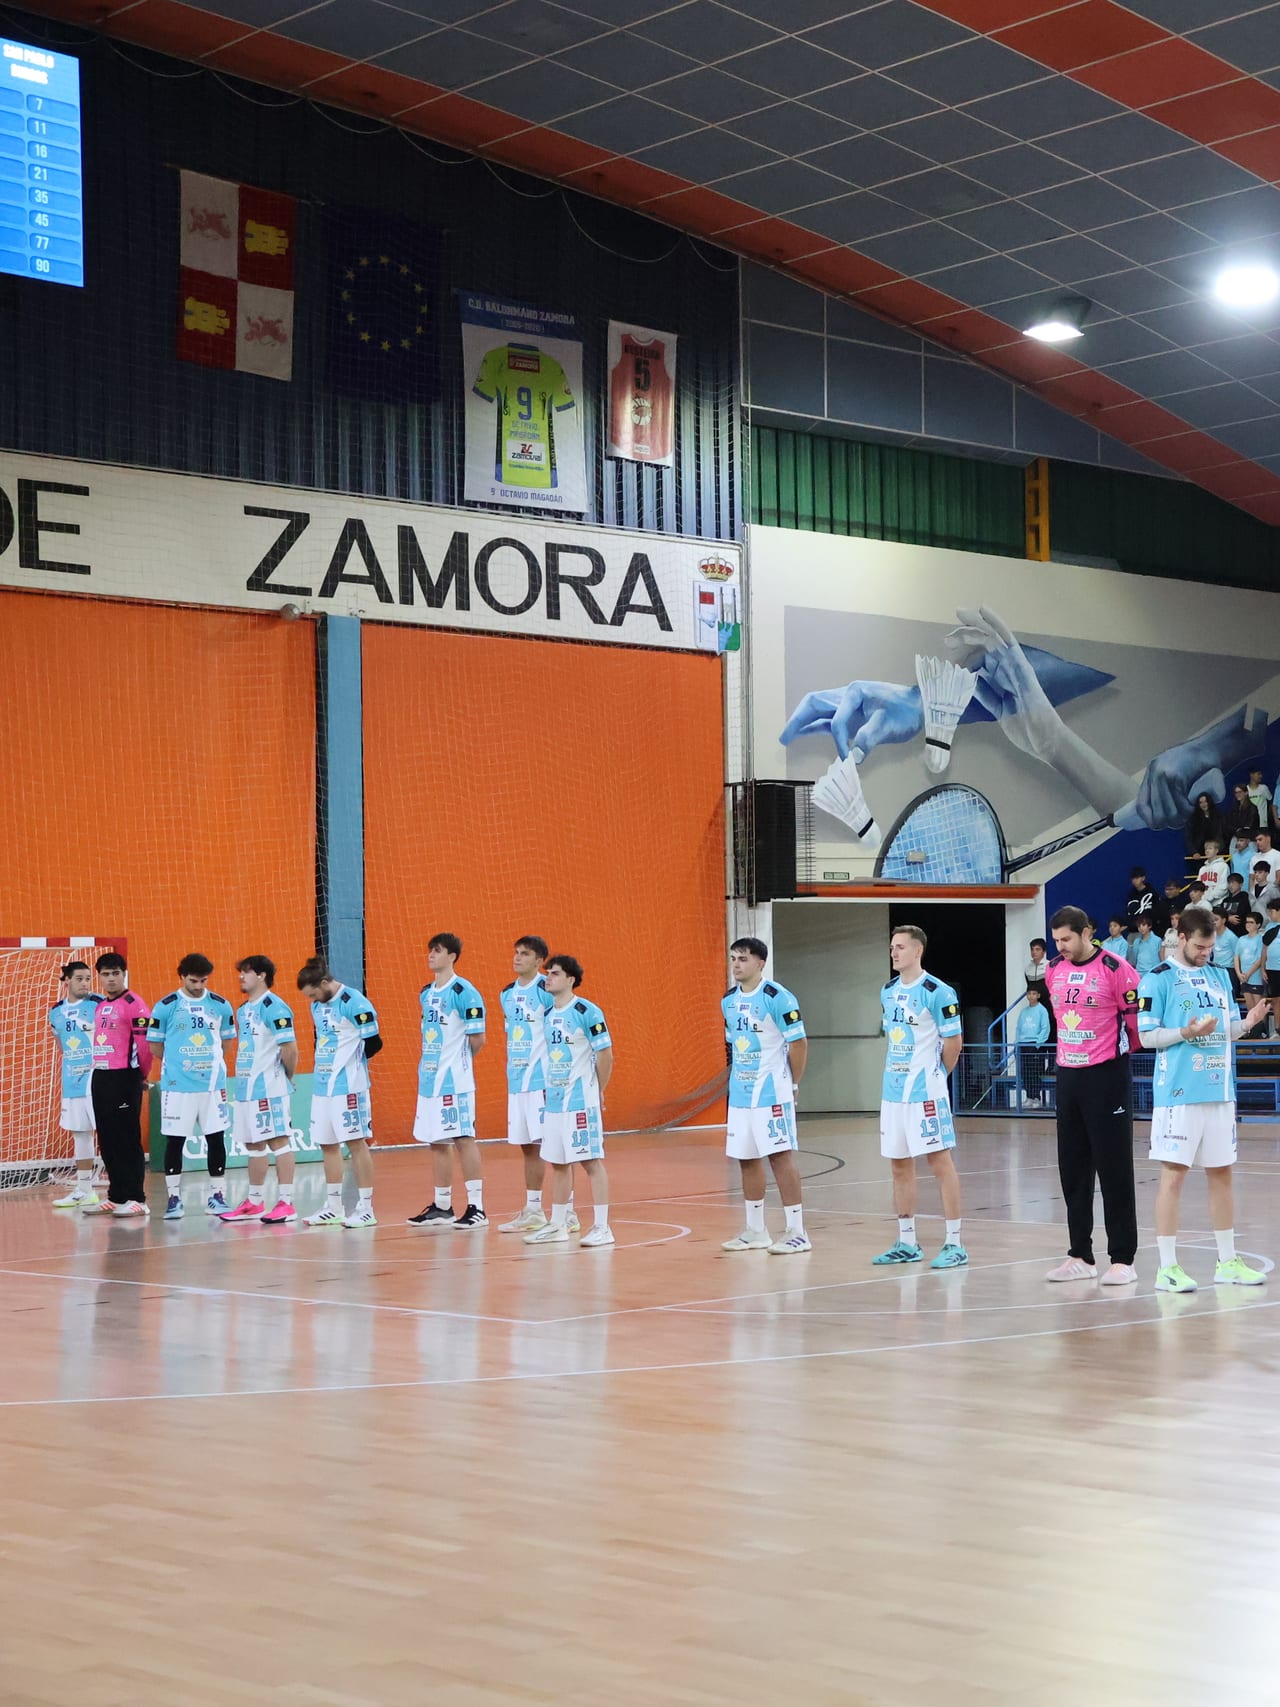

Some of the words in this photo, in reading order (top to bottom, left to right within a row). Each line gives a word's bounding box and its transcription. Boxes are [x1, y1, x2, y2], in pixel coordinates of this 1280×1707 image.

[36, 98, 43, 111] 7
[35, 121, 47, 135] 11
[35, 144, 48, 158] 16
[34, 166, 47, 181] 21
[35, 189, 49, 204] 35
[35, 213, 49, 227] 45
[36, 236, 49, 250] 77
[36, 259, 50, 273] 90
[540, 312, 575, 325] ZAMORA
[634, 357, 650, 391] 5
[517, 386, 532, 420] 9
[490, 487, 496, 496] 9
[500, 489, 528, 499] OCTAVIO
[0, 478, 92, 576] E
[244, 505, 673, 633] ZAMORA
[1070, 974, 1084, 982] gaza
[1064, 988, 1080, 1004] 12
[1197, 992, 1213, 1008] 11
[892, 1007, 905, 1023] 13
[65, 1020, 77, 1032] 87
[191, 1017, 204, 1029] 38
[736, 1017, 749, 1031] 14
[1069, 1031, 1095, 1039] RURAL
[255, 1111, 271, 1129] 37
[342, 1111, 360, 1128] 33
[440, 1107, 458, 1124] 30
[768, 1118, 788, 1137] 14
[920, 1118, 940, 1137] 13
